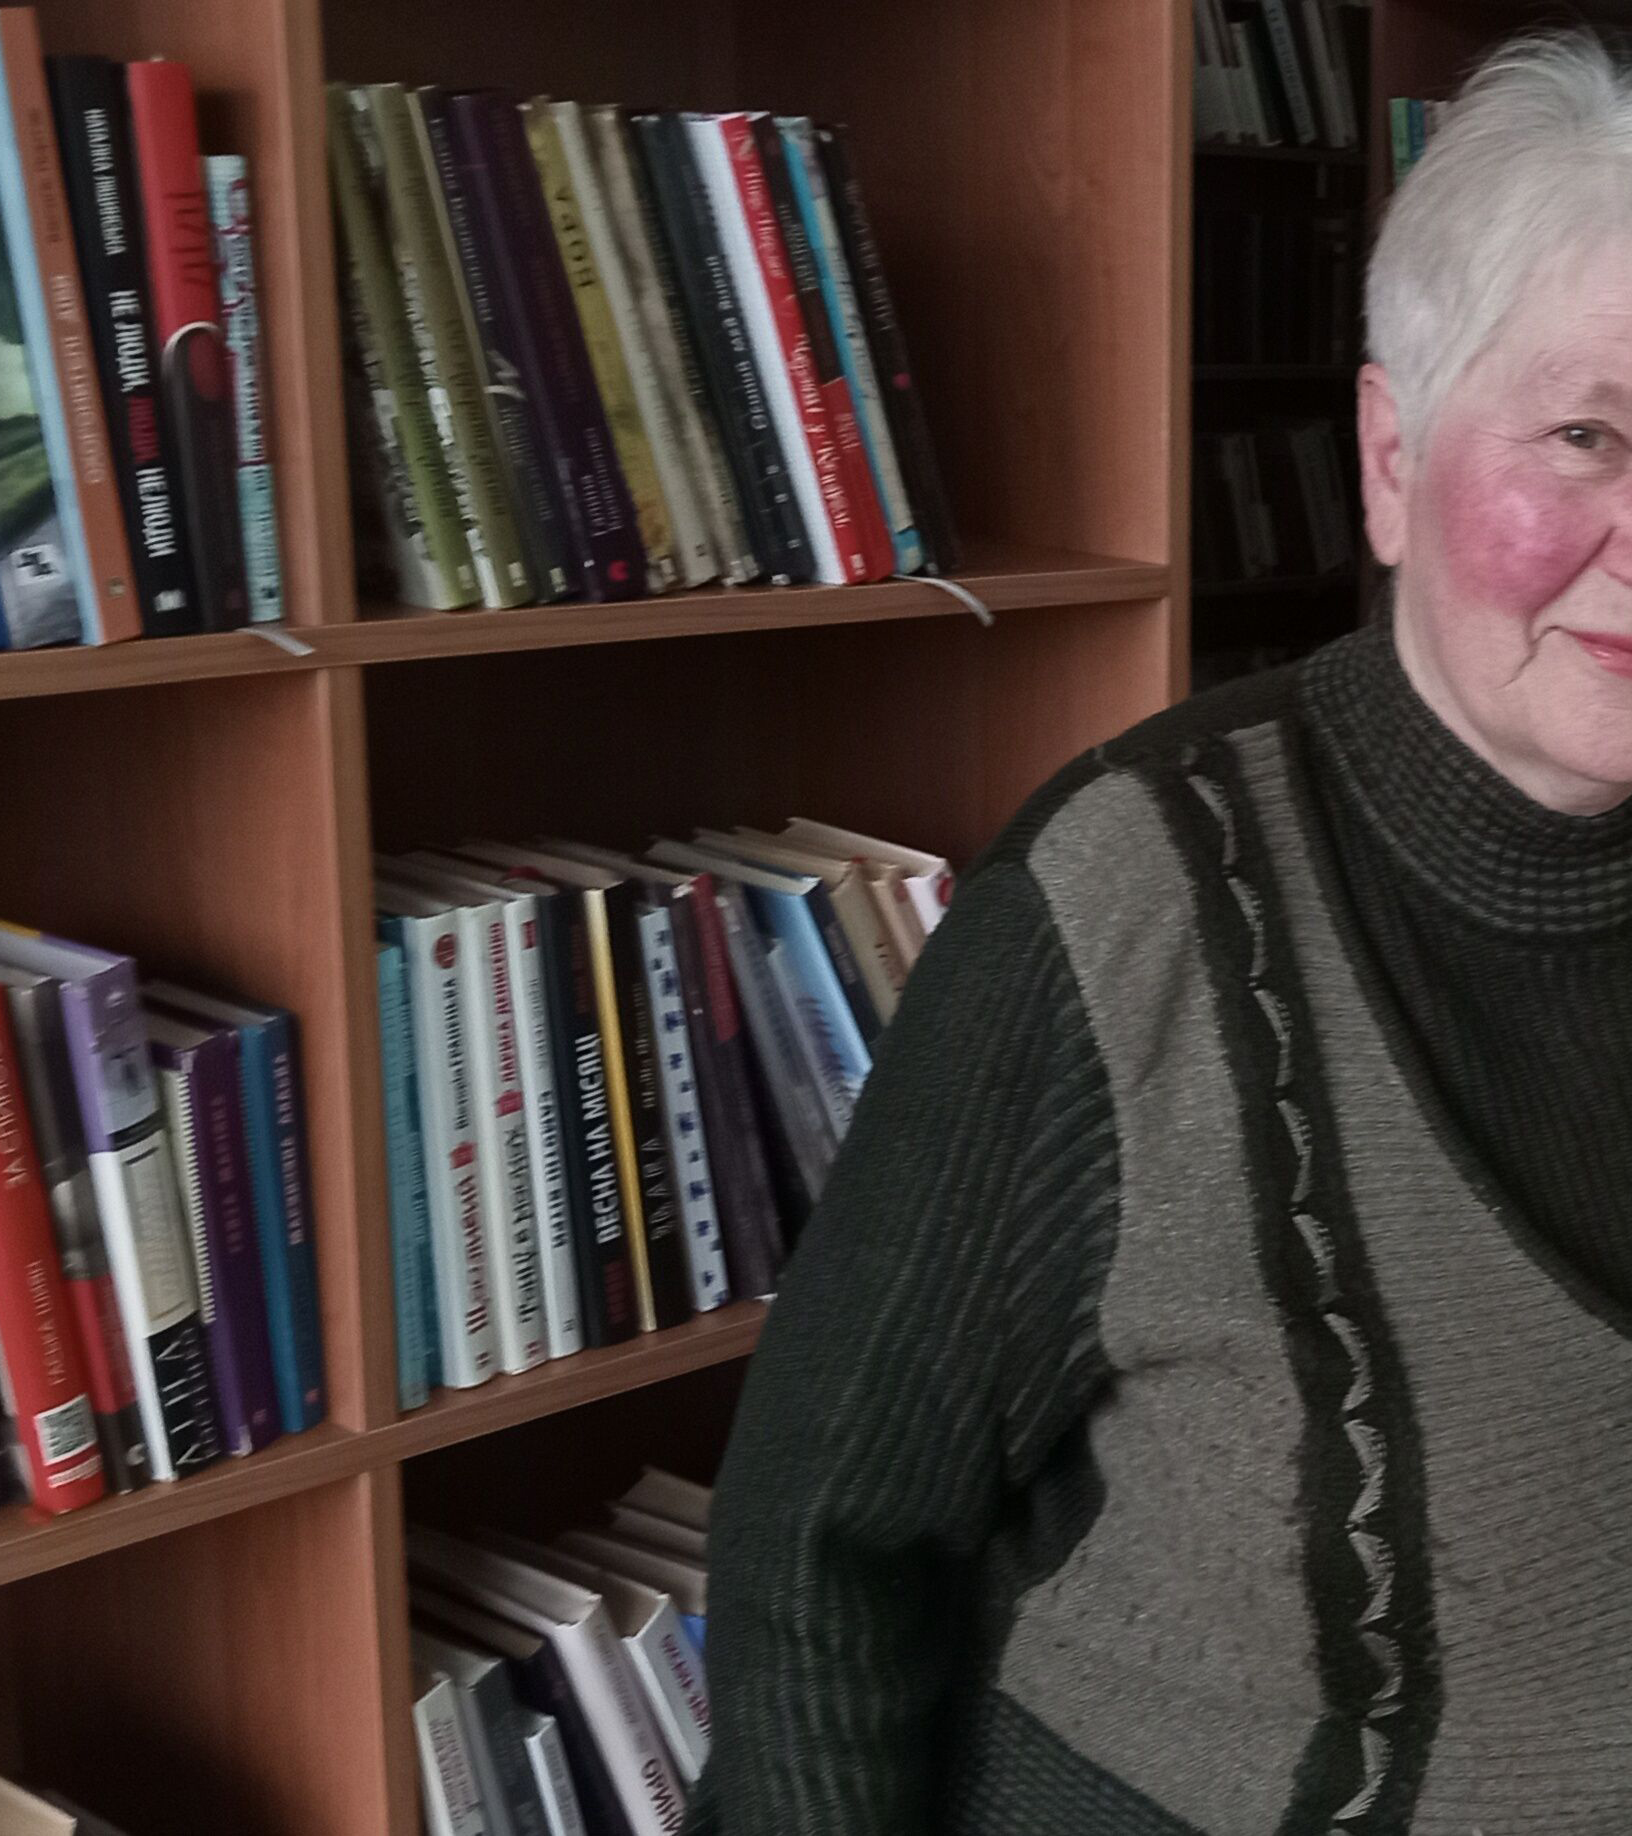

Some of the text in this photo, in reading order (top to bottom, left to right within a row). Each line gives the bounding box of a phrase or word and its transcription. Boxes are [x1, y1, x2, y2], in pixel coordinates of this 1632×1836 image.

[109, 290, 139, 320] НЕ
[137, 467, 176, 560] НЕЛЮДИ
[575, 1033, 608, 1120] МІСЯЦІ
[4, 1153, 30, 1187] ЗА
[584, 1122, 612, 1160] НА
[588, 1163, 622, 1243] ВЕСНА
